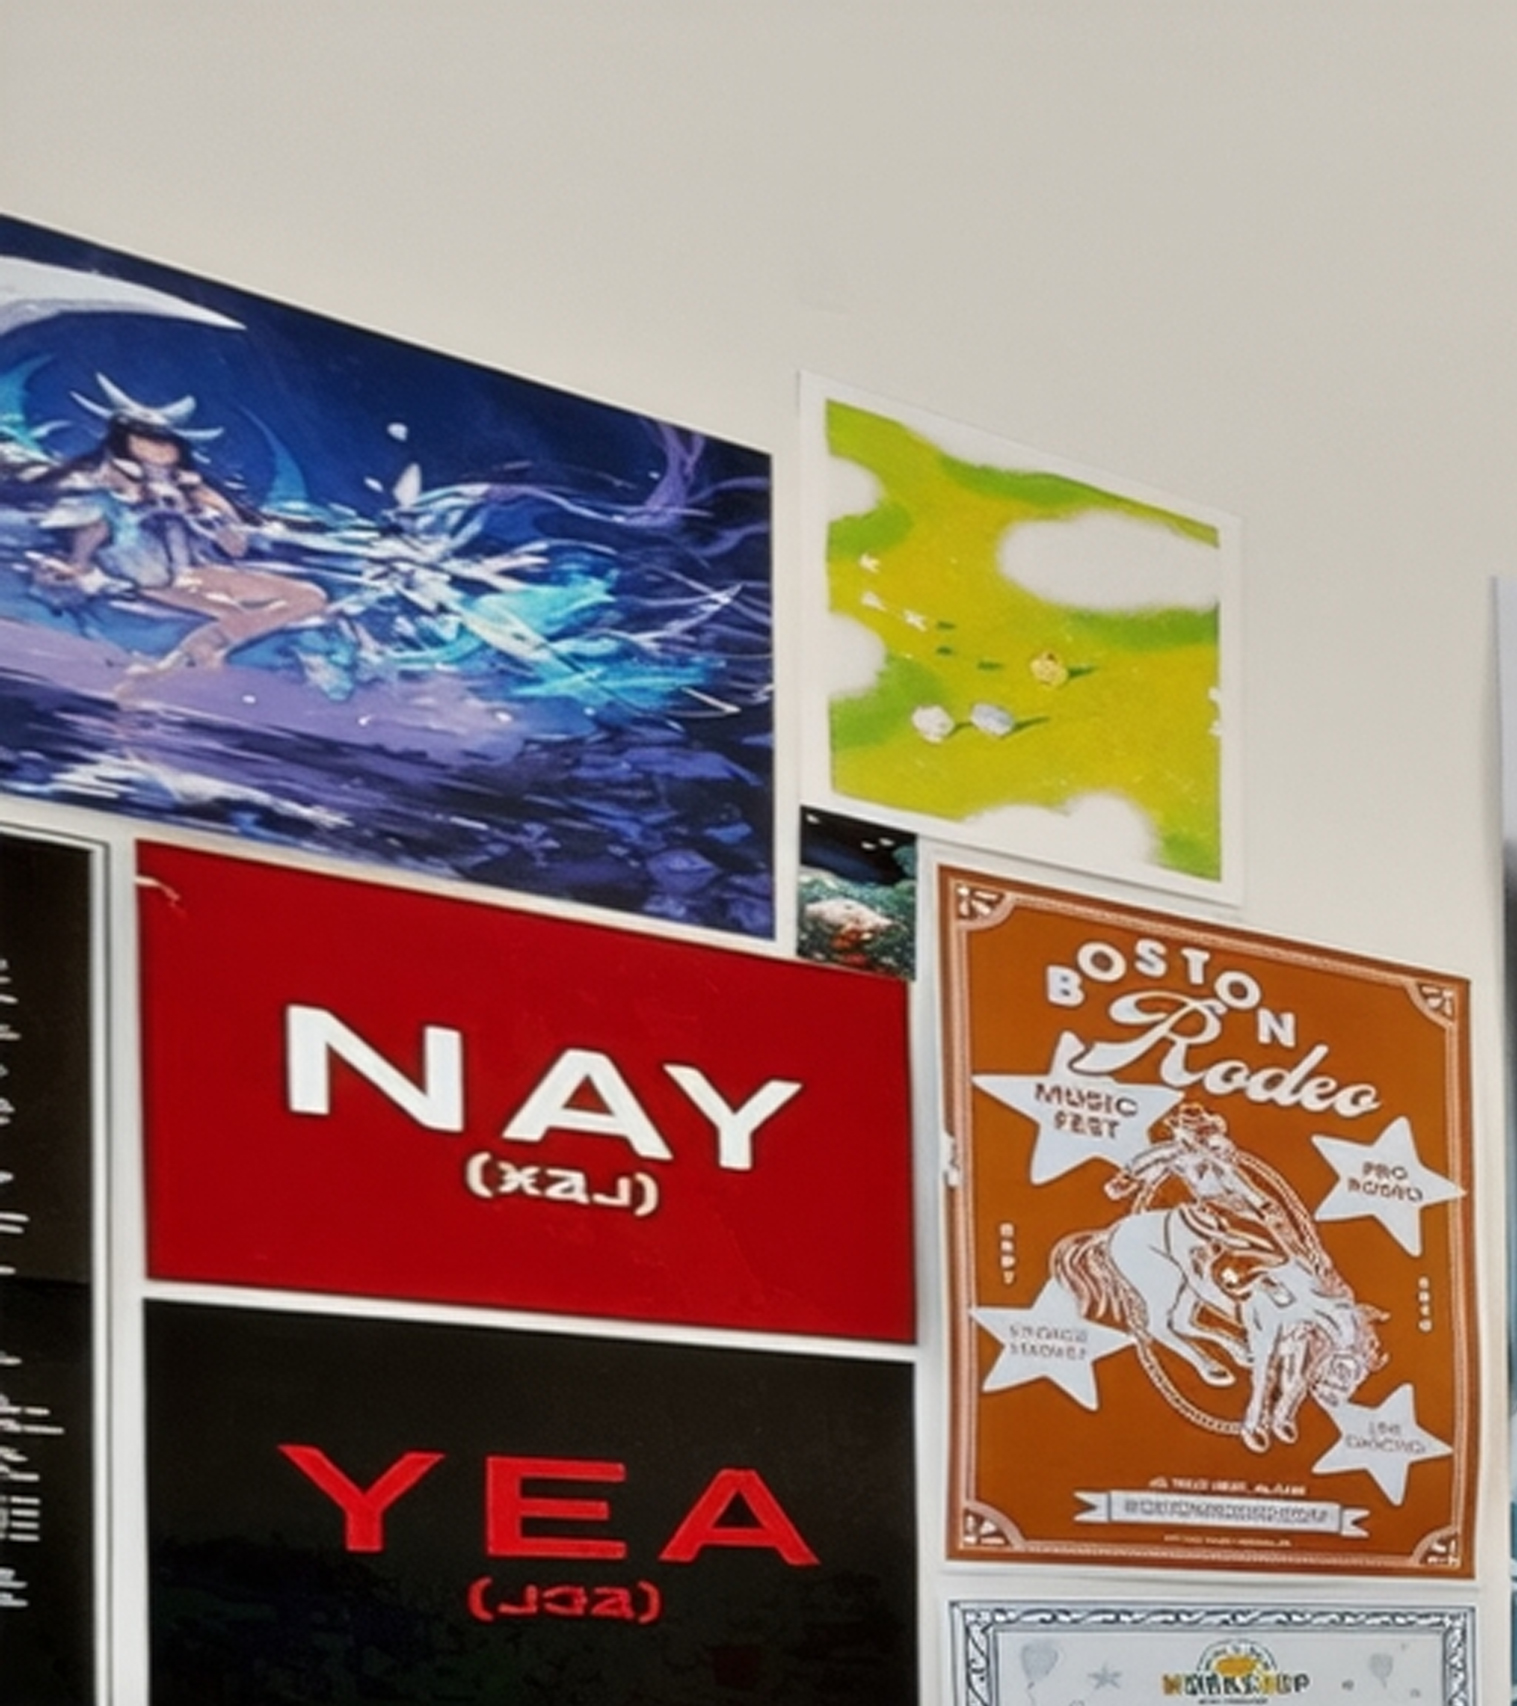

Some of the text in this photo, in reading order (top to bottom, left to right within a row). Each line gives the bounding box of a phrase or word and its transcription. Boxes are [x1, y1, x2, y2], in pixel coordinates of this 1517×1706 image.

[1046, 938, 1296, 1048] BOSTON
[1069, 989, 1382, 1118] Rodeo
[285, 1003, 803, 1171] NAY
[1033, 1082, 1139, 1118] MUSIC
[276, 1443, 822, 1567] YEA
